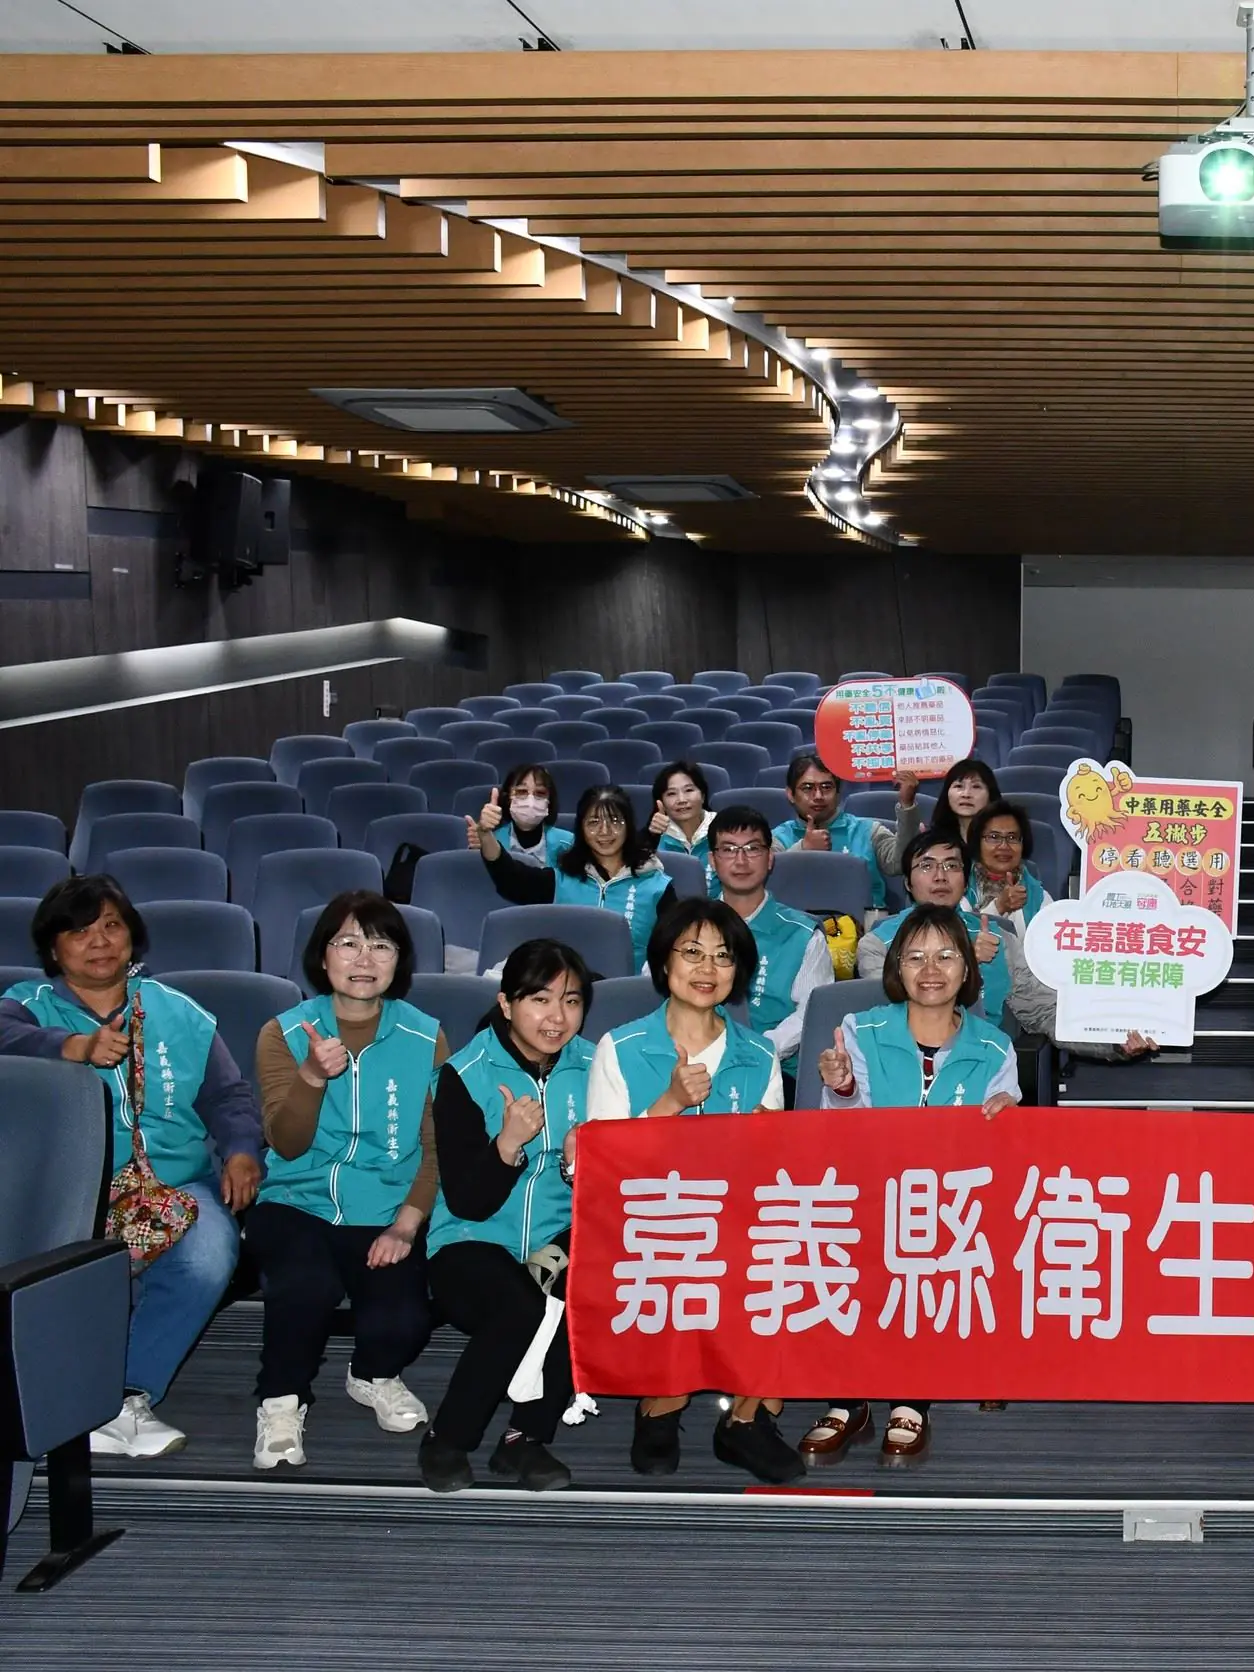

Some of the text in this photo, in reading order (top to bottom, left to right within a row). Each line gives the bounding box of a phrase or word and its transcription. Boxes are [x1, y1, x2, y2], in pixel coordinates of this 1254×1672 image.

[1125, 796, 1227, 819] 中藥用藥安全
[1142, 820, 1208, 846] 五撇步
[1053, 919, 1207, 958] 在嘉護食安
[1072, 958, 1185, 989] 稽查有保障
